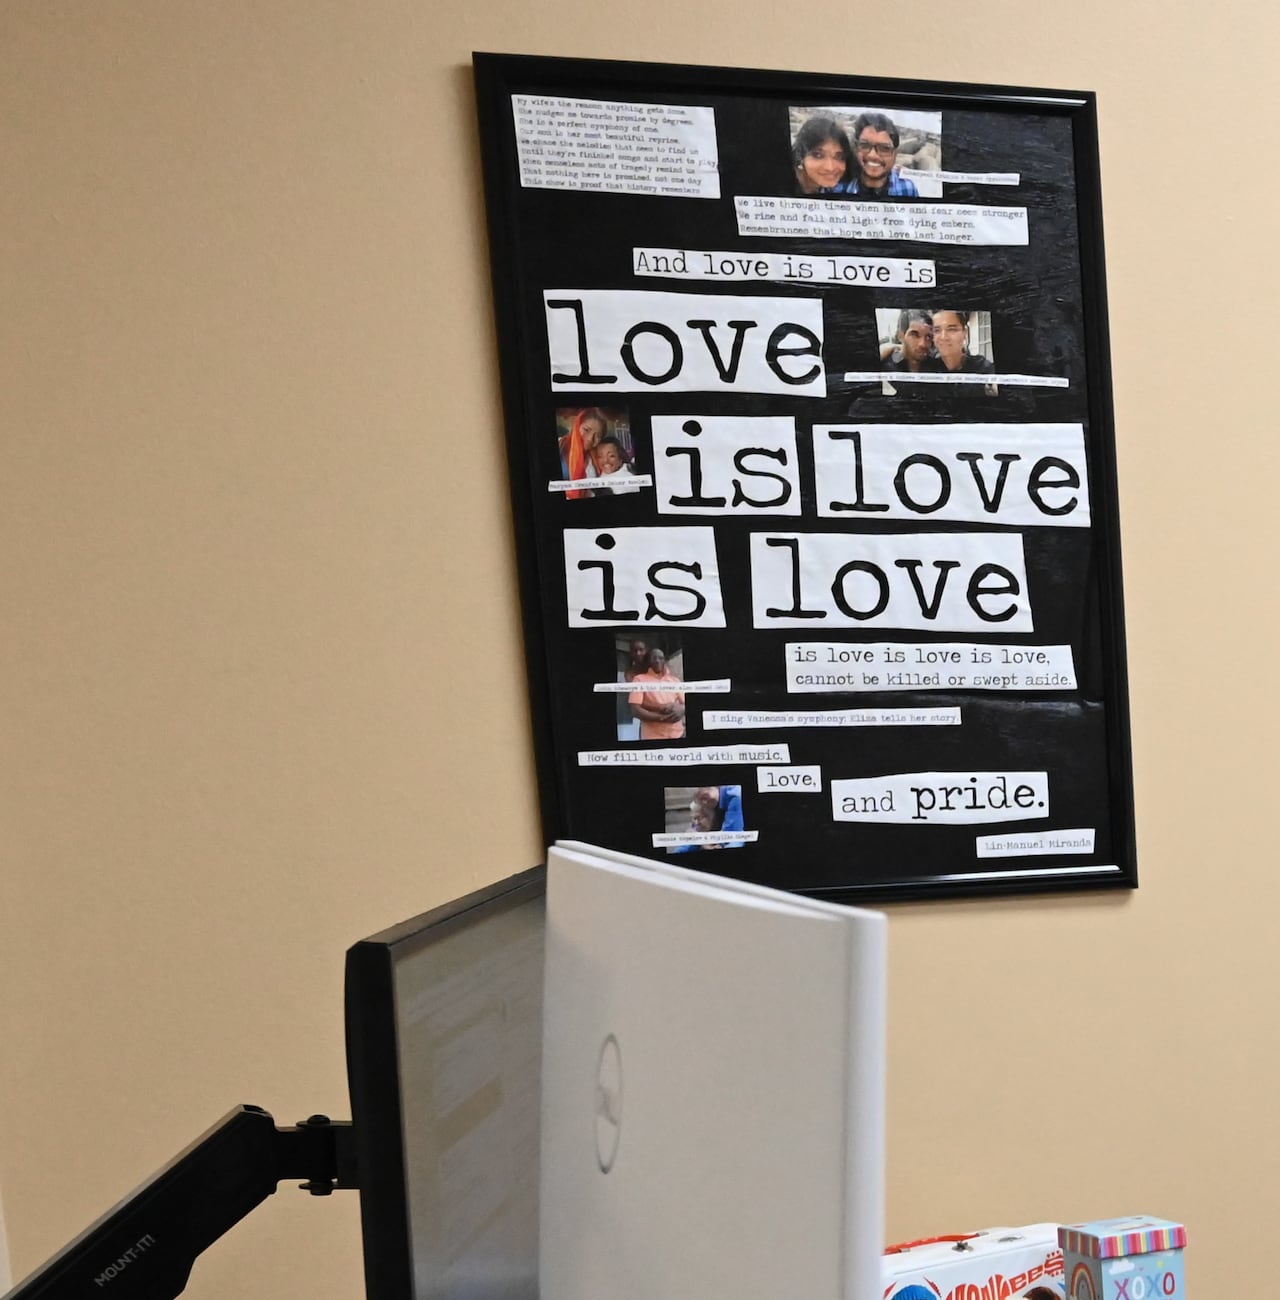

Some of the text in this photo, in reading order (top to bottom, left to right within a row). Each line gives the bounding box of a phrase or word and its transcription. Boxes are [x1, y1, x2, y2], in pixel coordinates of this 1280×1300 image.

[558, 100, 571, 108] the
[606, 104, 643, 115] anything
[754, 198, 775, 208] live
[779, 199, 820, 212] through
[854, 203, 879, 213] when
[883, 204, 906, 214] hate
[909, 205, 928, 214] and
[982, 208, 1025, 221] stronger
[780, 211, 798, 221] and
[802, 212, 825, 223] fall
[829, 214, 847, 223] and
[851, 214, 880, 227] light
[882, 216, 905, 226] from
[908, 217, 938, 230] dying
[812, 225, 835, 235] that
[840, 227, 863, 239] hope
[866, 229, 886, 238] and
[888, 229, 910, 239] love
[636, 251, 934, 284] And love is love is
[547, 299, 821, 386] love
[665, 419, 1081, 515] is love
[577, 533, 1020, 622] is love
[794, 646, 1050, 667] is love is love is love,
[795, 672, 1072, 689] cannot be killed or swept aside.
[720, 713, 744, 725] sing
[882, 712, 907, 722] tells
[911, 711, 927, 722] her
[613, 751, 640, 763] fill
[645, 751, 663, 762] the
[670, 750, 703, 762] world
[707, 750, 734, 761] with
[767, 771, 817, 789] love,
[841, 777, 1046, 820] and pride.
[93, 1234, 156, 1288] MOUNT-IT!
